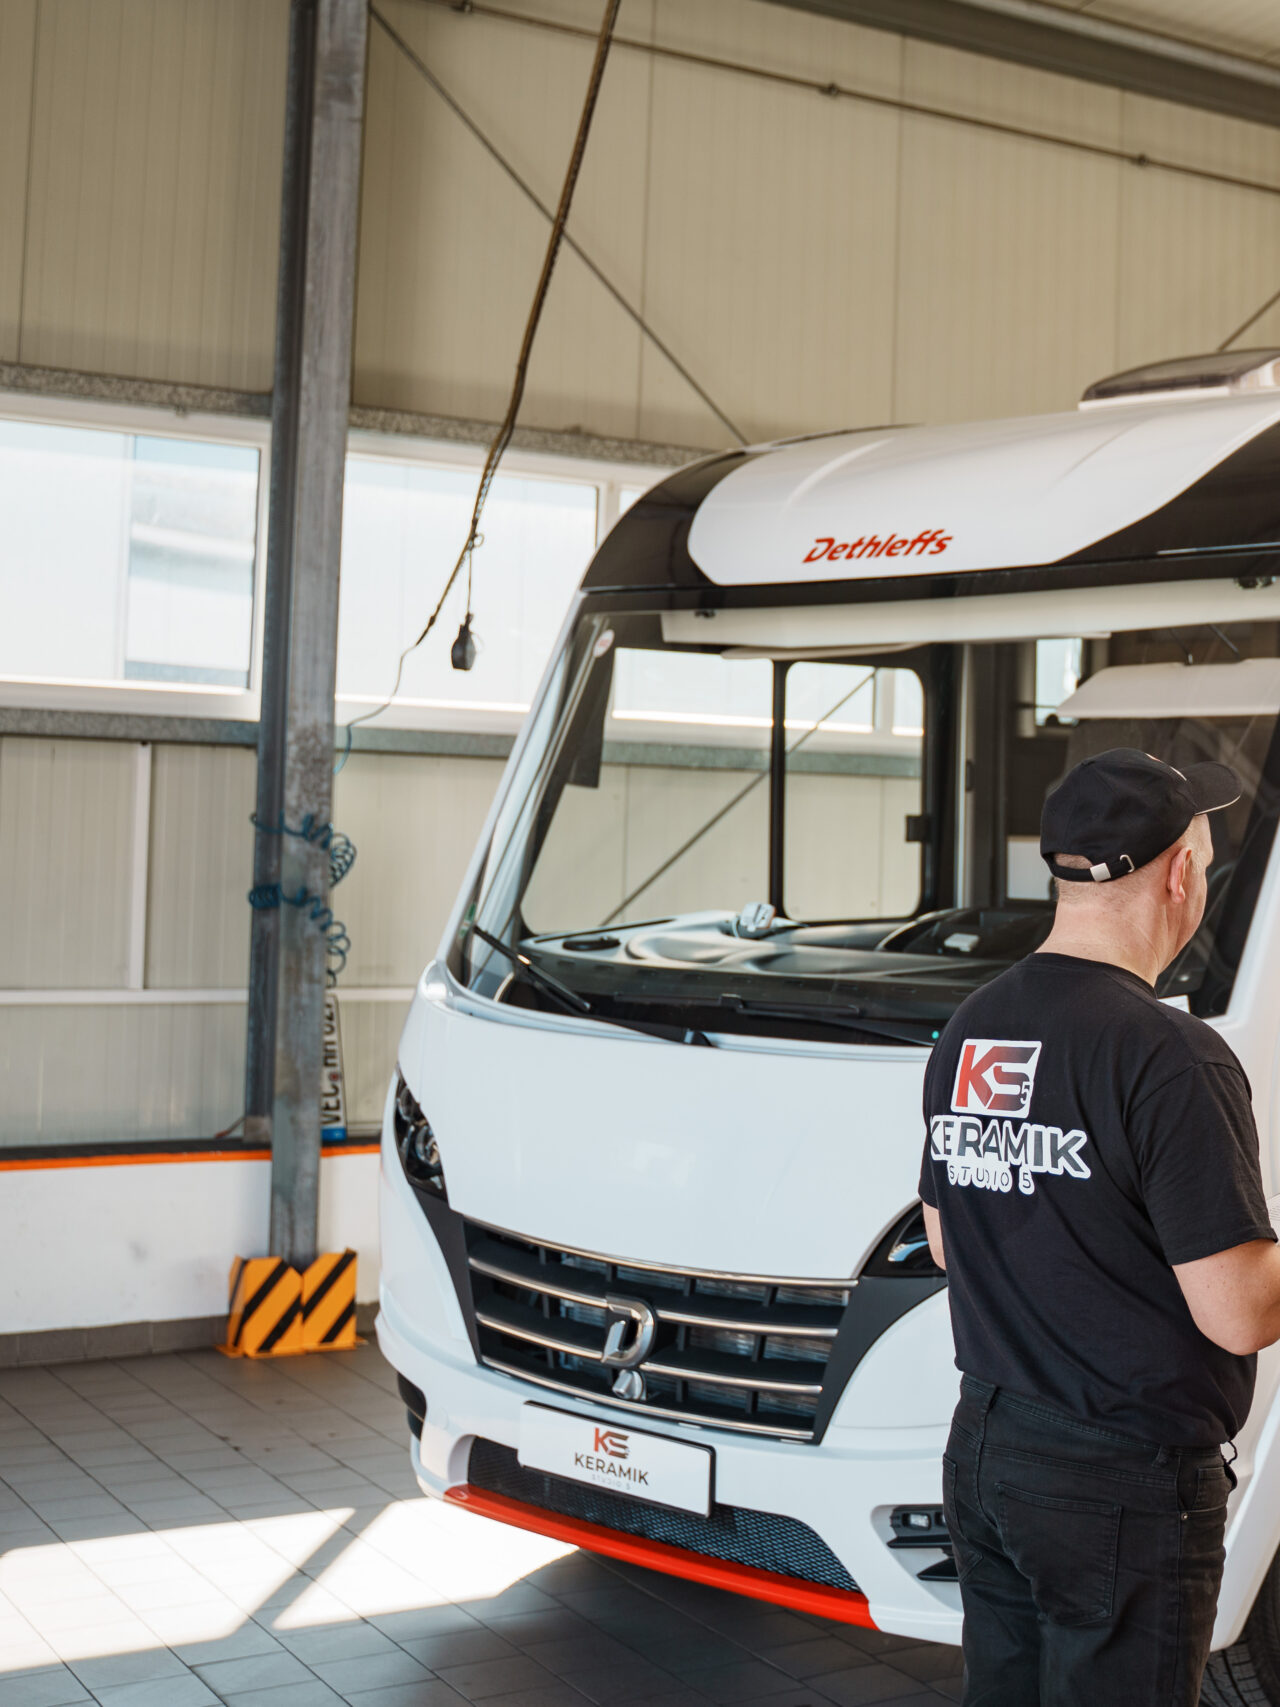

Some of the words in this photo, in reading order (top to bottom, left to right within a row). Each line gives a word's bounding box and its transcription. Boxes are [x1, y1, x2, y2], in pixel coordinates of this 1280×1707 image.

[802, 528, 953, 564] Dethleffs
[930, 1119, 1086, 1173] KERAMIK
[1022, 1171, 1032, 1189] 5
[574, 1452, 649, 1486] KERAMIK
